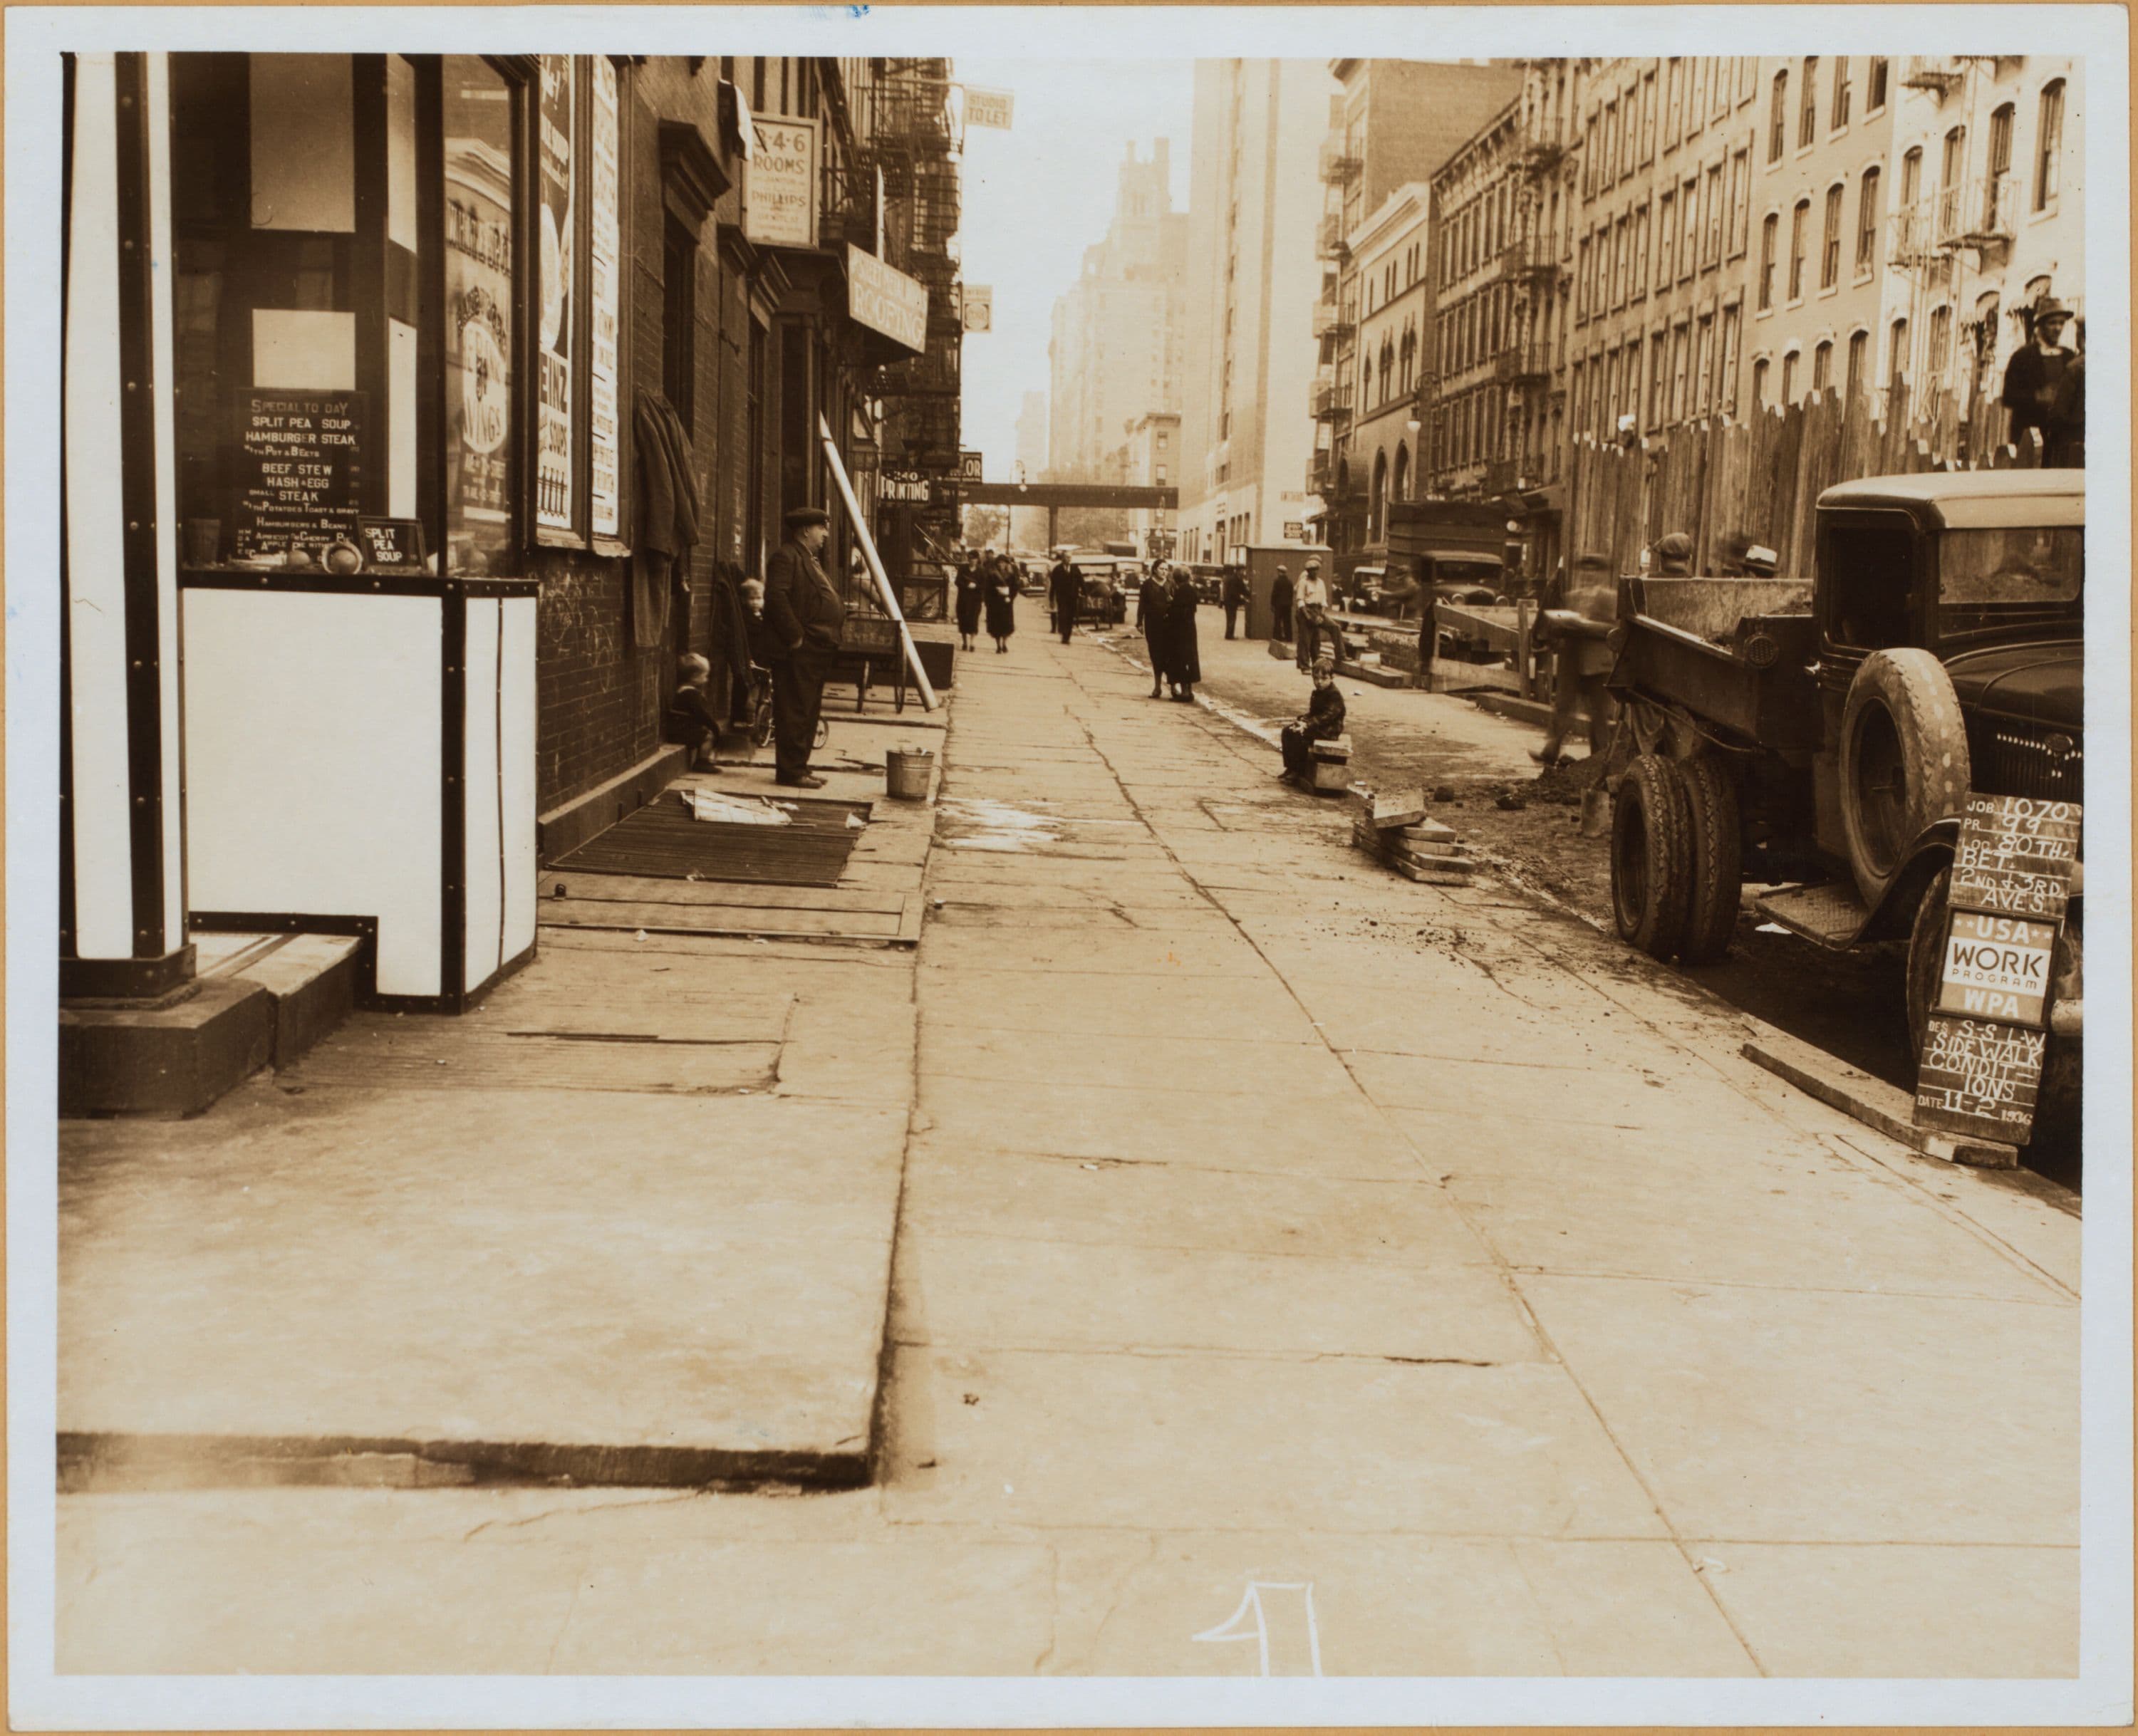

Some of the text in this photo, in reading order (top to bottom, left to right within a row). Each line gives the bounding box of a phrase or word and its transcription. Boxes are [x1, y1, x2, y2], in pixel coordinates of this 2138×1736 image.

[753, 152, 805, 175] ROOMS
[854, 281, 924, 345] ROOFING
[539, 352, 568, 415] EINZ
[251, 399, 301, 413] SPECIAL
[252, 416, 351, 430] SPLIT PEA SOUP
[245, 431, 356, 445] HAMBURGER STEAK
[262, 463, 293, 474] BEEF
[298, 464, 332, 475] STEW
[266, 477, 299, 488] HASH
[307, 478, 329, 489] EGG
[881, 475, 929, 501] PRINTING
[279, 490, 319, 501] STEAK
[365, 528, 395, 539] SPLIT
[373, 539, 394, 551] PEA
[376, 551, 403, 563] SOUP
[1967, 796, 2069, 820] JOB 1070
[1963, 815, 2041, 835] PR 99
[1961, 868, 1996, 890] 2ND
[1981, 889, 2045, 913] AVES
[1976, 915, 2030, 944] USA
[1953, 942, 2044, 977] WORK
[1952, 968, 2037, 989] PROGRAM
[1964, 988, 2018, 1019] WPA
[1964, 1075, 2015, 1101] IONS
[1918, 1095, 1943, 1108] DATE
